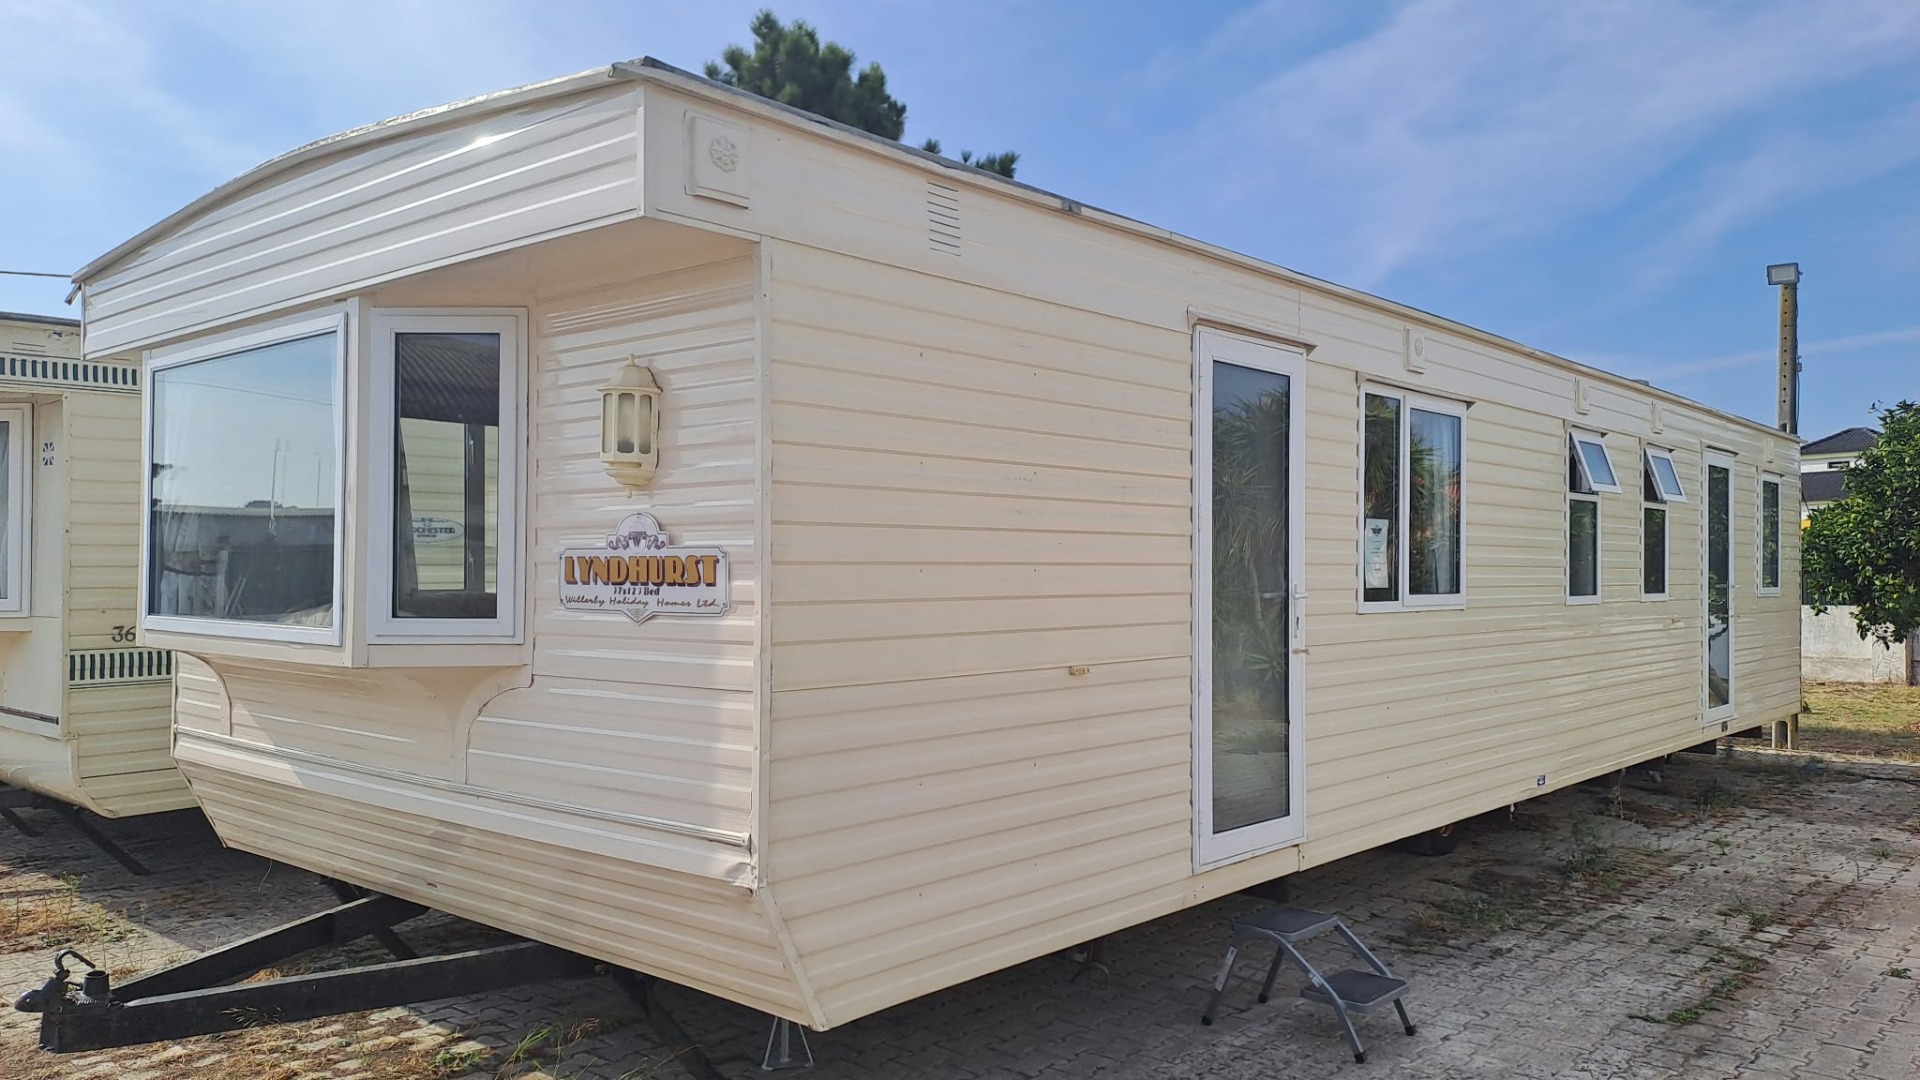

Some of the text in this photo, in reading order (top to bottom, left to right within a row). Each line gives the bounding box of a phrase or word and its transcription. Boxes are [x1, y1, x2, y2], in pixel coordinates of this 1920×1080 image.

[564, 555, 719, 587] LYNDHURST
[643, 587, 660, 595] Bed
[565, 595, 605, 607] Willerby
[609, 596, 649, 608] Holiday
[656, 597, 692, 607] Homes
[111, 625, 136, 643] 36
